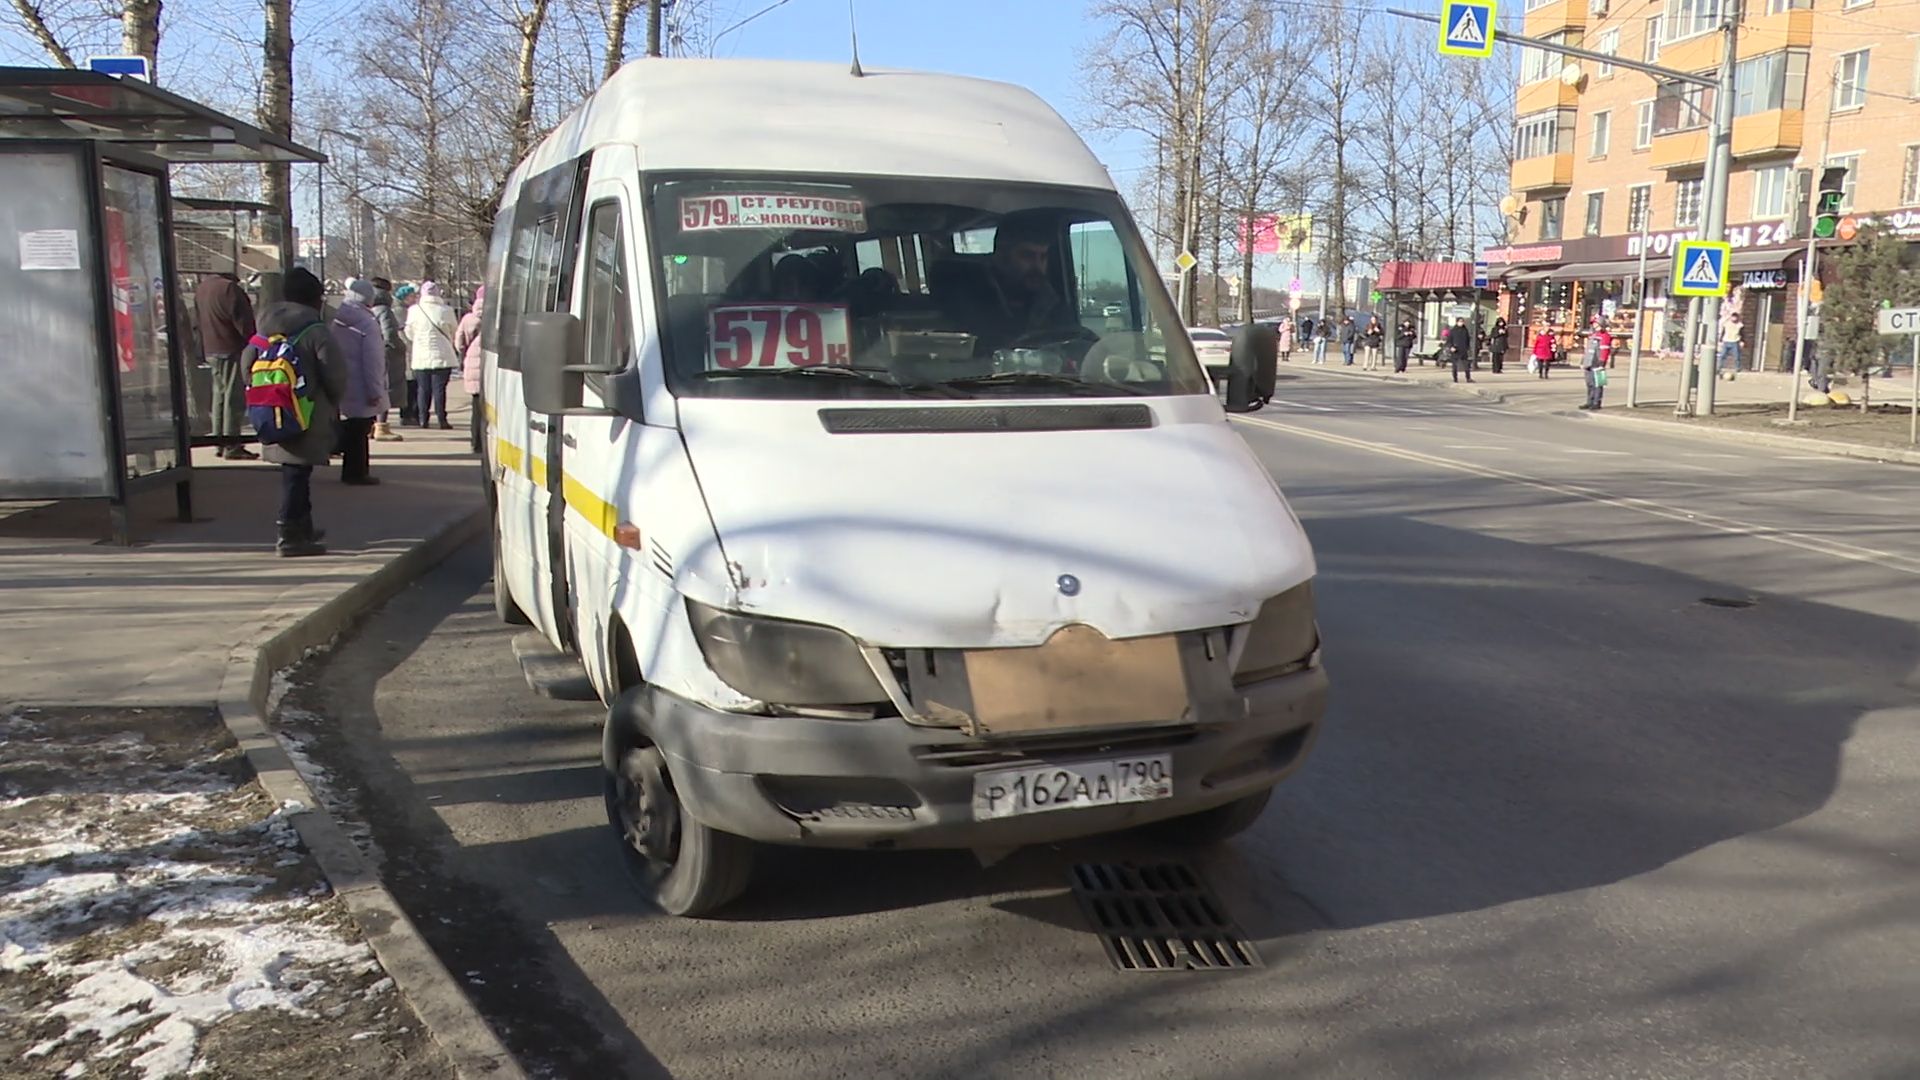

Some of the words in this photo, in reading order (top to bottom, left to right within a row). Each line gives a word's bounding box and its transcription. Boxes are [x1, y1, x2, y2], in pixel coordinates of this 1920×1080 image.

[741, 197, 772, 209] СТ.
[1756, 223, 1787, 246] 24
[1743, 271, 1776, 289] ТАБАК
[1891, 312, 1920, 329] СТ
[1118, 760, 1164, 787] 790
